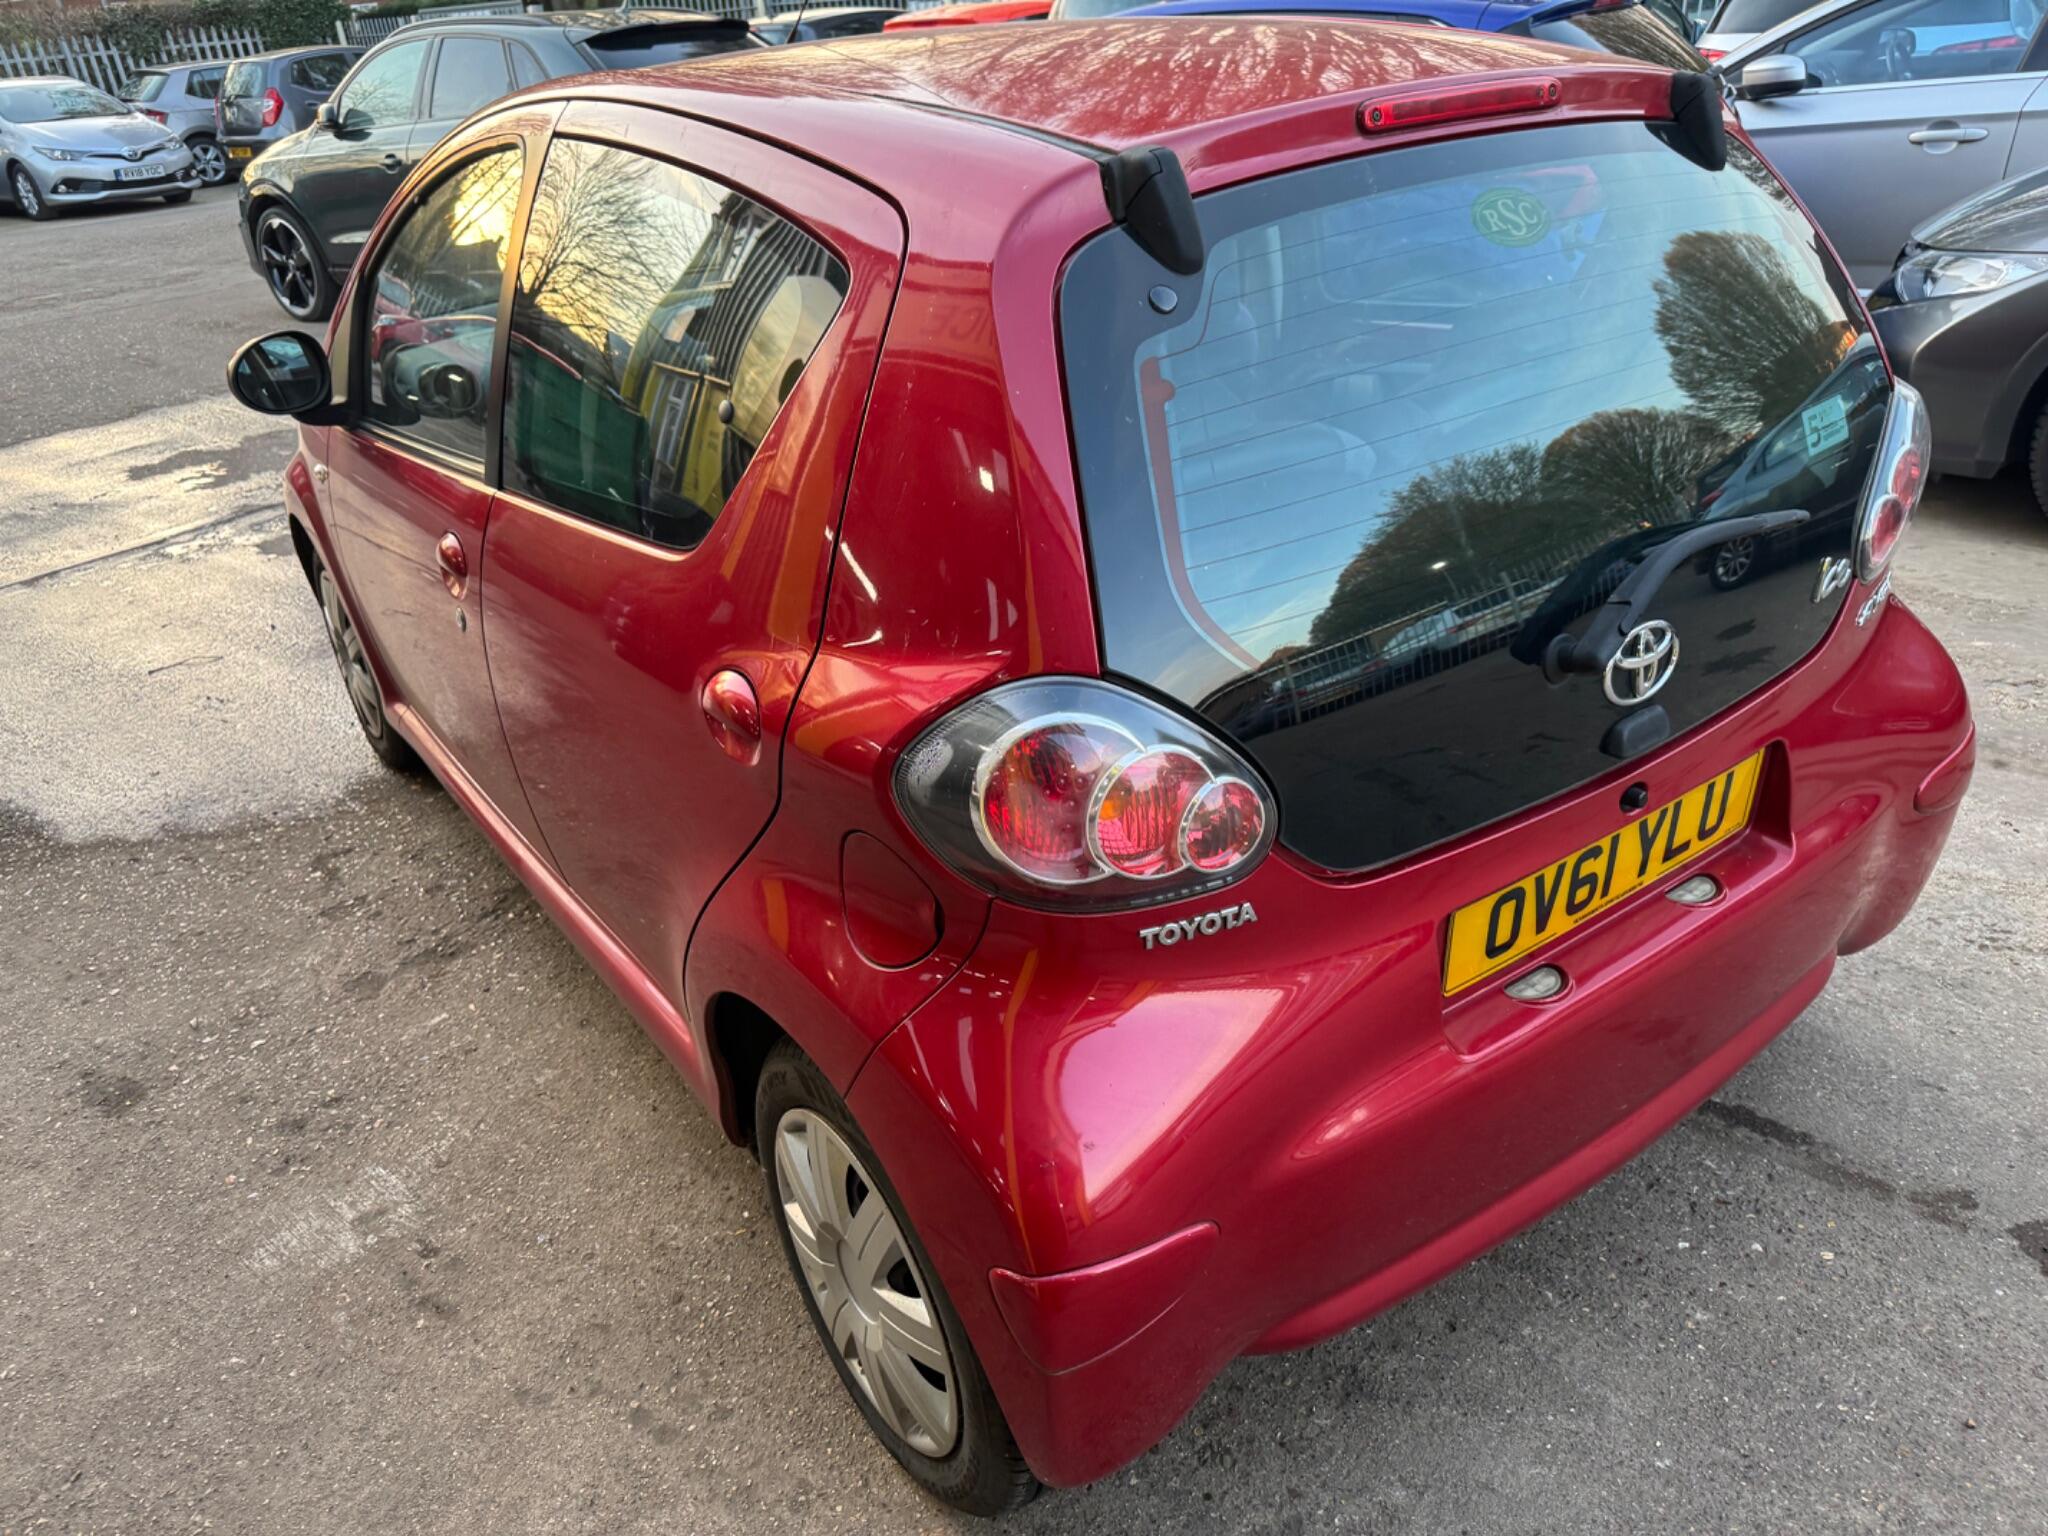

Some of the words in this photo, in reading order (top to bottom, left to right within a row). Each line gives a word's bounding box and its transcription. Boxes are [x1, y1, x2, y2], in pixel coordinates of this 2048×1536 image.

[1481, 198, 1538, 236] RSC
[1485, 833, 1620, 960] OV61
[1637, 770, 1735, 878] YLU
[1139, 902, 1258, 950] TOYOTA
